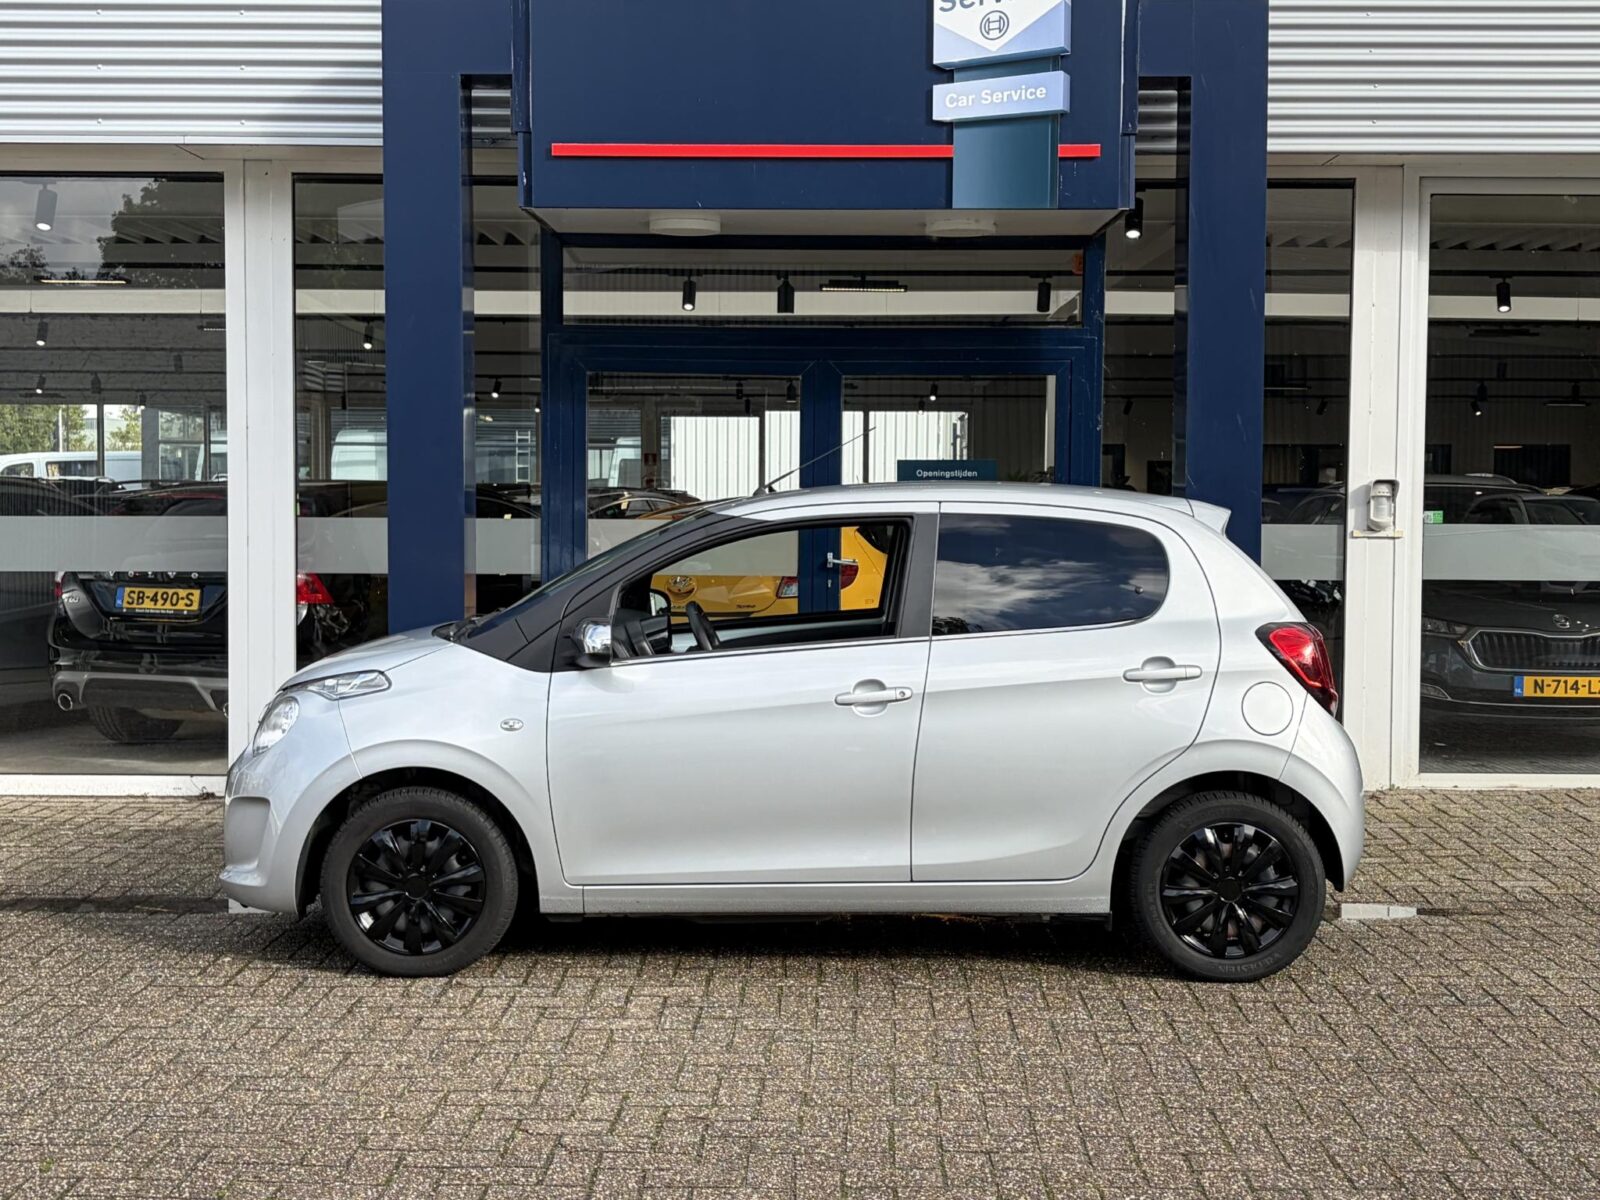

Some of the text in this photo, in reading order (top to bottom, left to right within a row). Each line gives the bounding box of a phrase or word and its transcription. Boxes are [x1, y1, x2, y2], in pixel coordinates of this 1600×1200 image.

[945, 85, 1047, 108] Car Service
[916, 469, 978, 479] Openingstijden
[126, 590, 195, 607] SB-490-S
[1533, 679, 1600, 695] N-714-L
